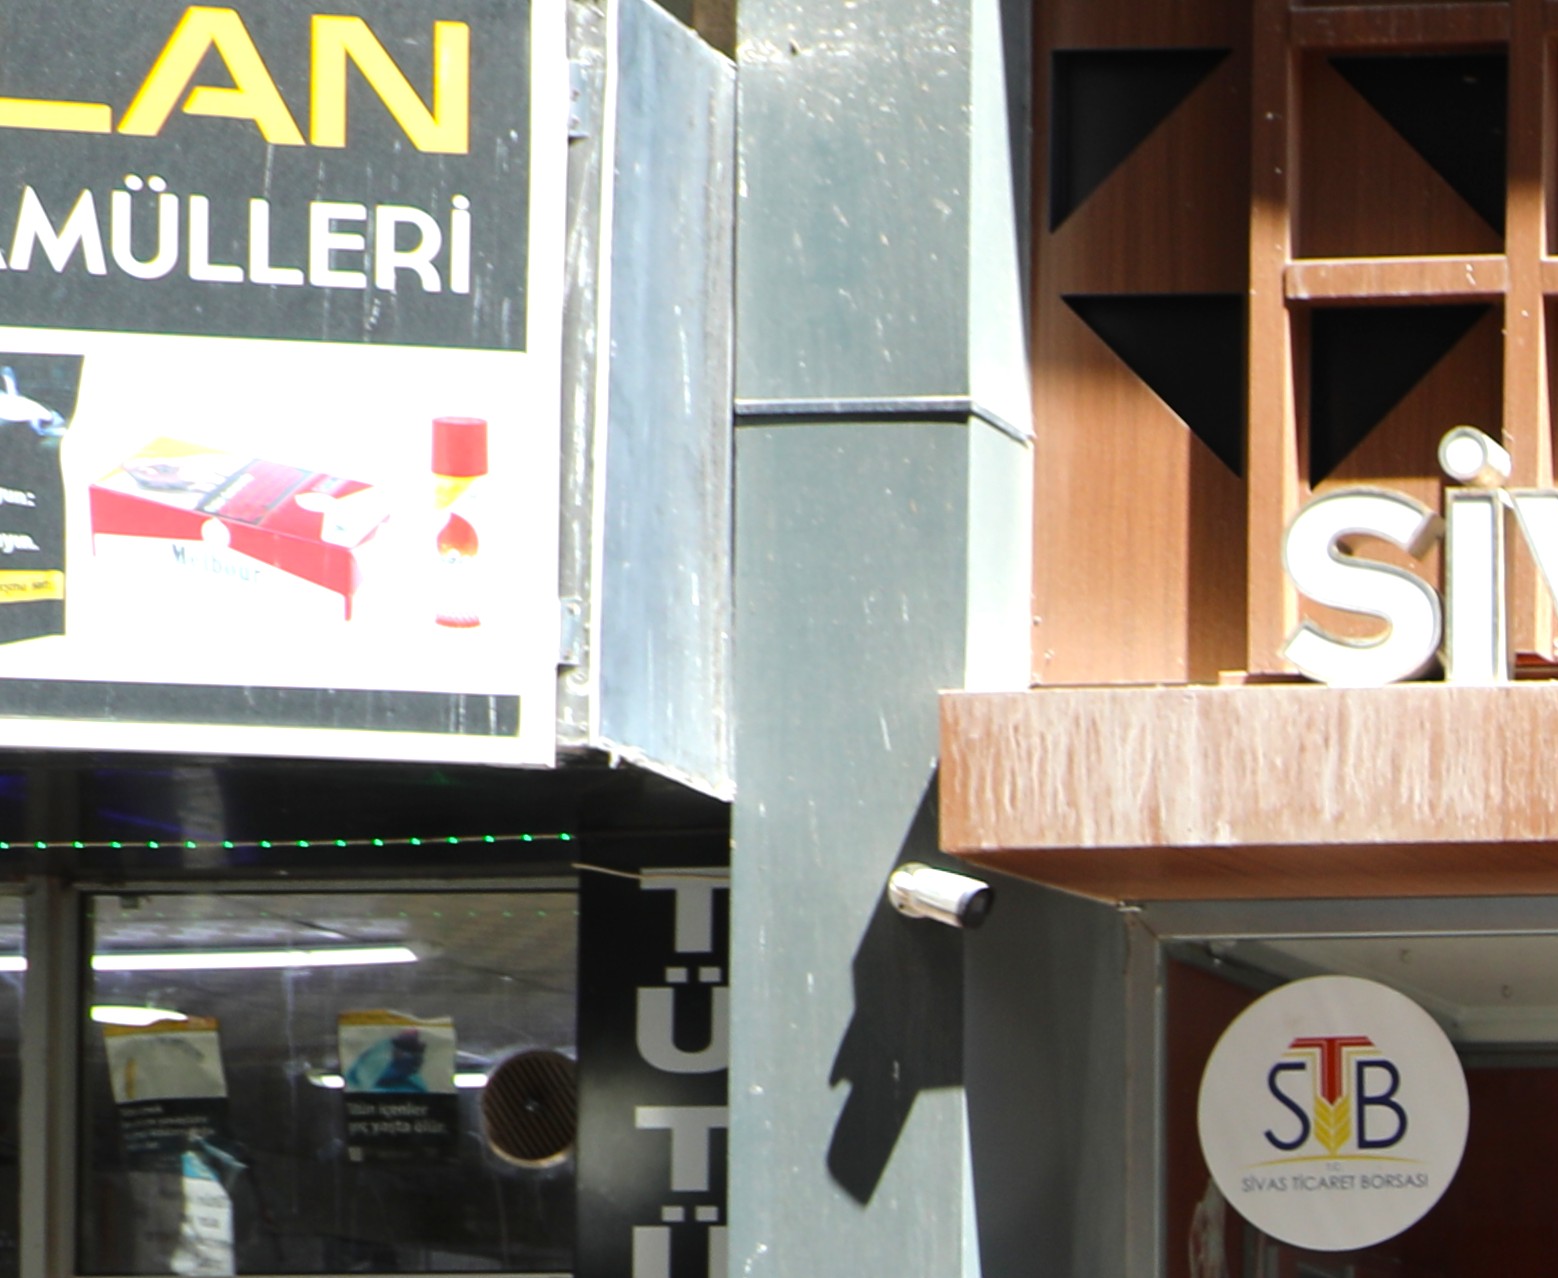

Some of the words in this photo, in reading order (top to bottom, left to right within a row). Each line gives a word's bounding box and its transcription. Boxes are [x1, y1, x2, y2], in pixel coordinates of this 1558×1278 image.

[0, 173, 471, 294] MÜLLERİ
[1241, 1176, 1289, 1193] SİVAS
[1292, 1174, 1356, 1191] TİCARET
[1361, 1173, 1429, 1190] BORSASI
